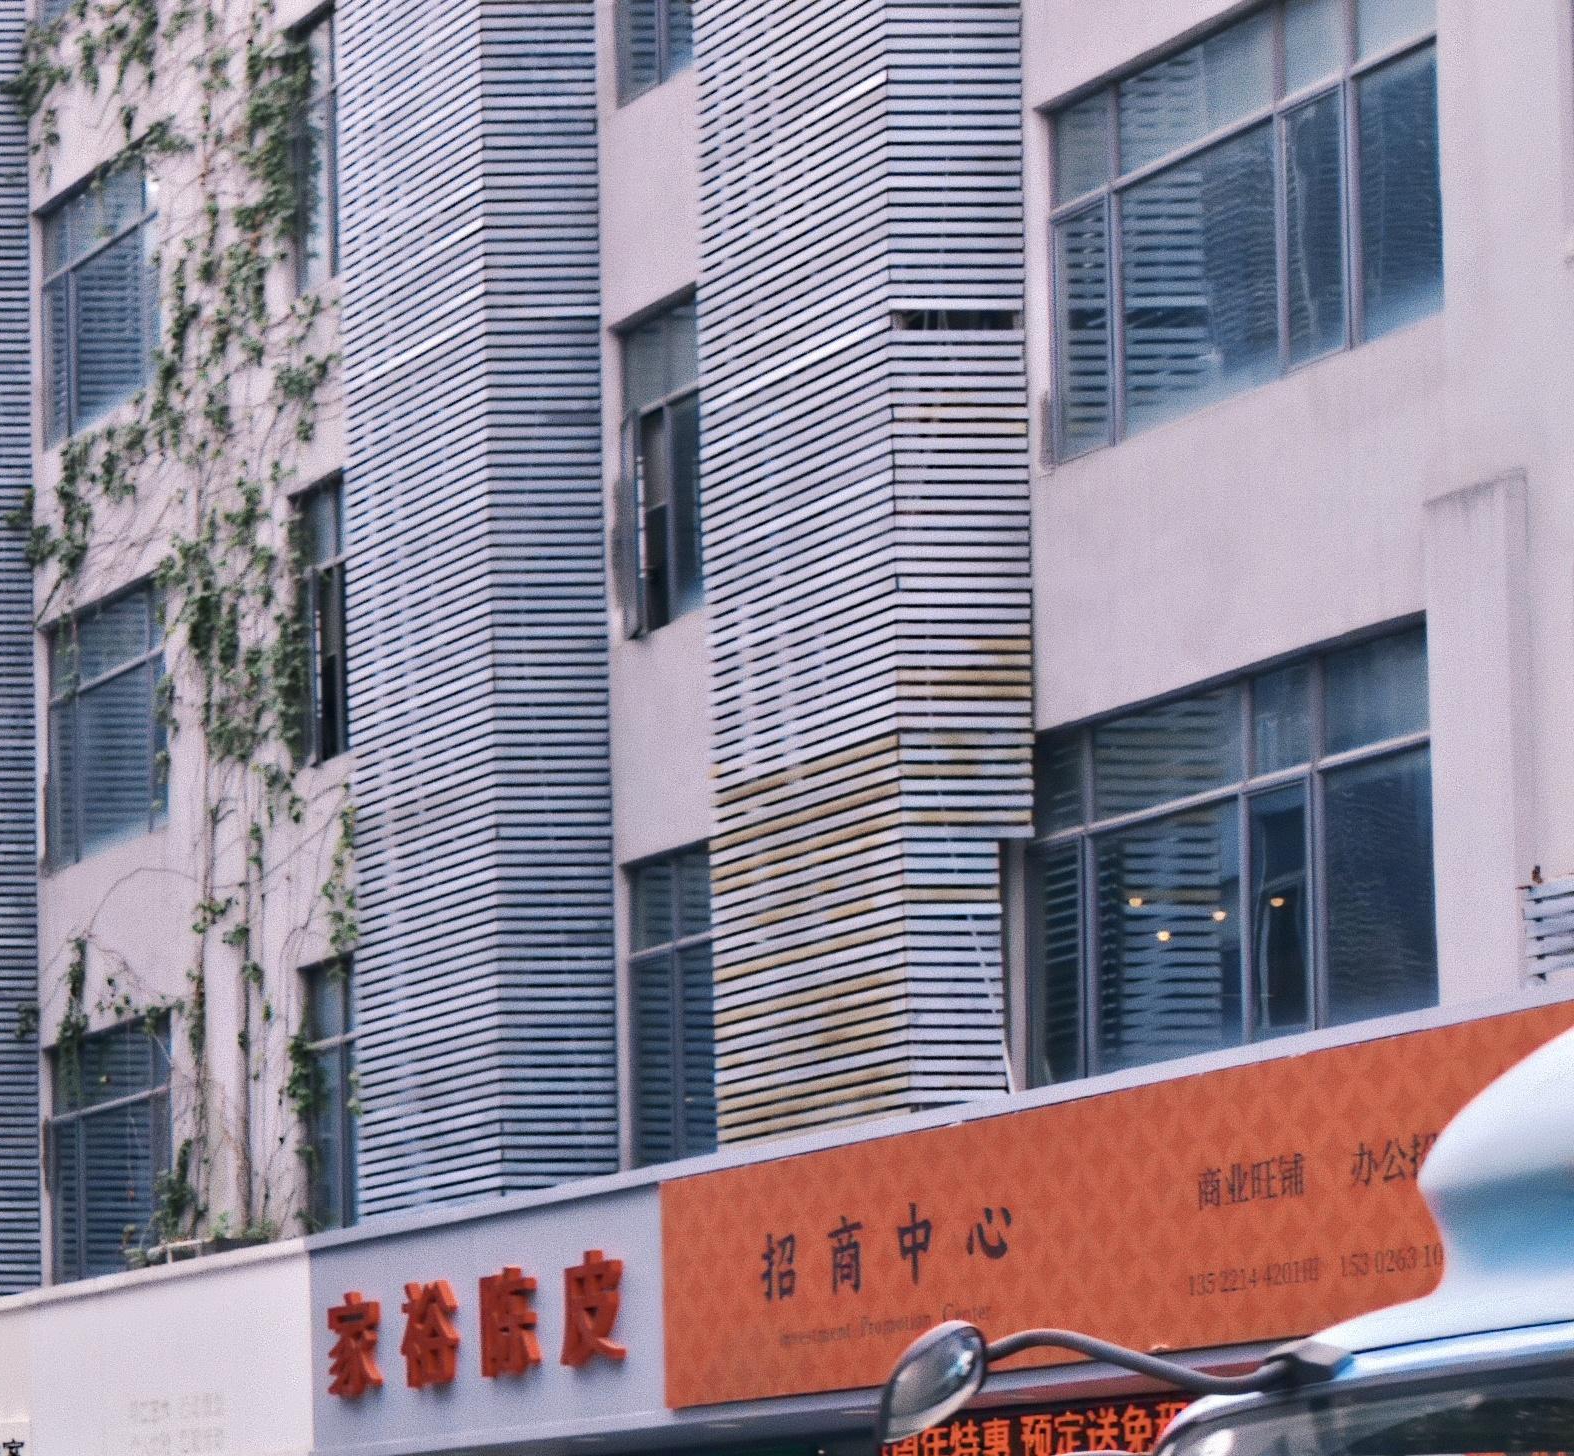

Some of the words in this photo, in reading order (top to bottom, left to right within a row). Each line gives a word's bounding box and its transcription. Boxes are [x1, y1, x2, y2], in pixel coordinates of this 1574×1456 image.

[761, 1202, 1013, 1302] 招商中心
[1423, 1241, 1444, 1270] 10
[327, 1250, 627, 1399] 家裕陈皮
